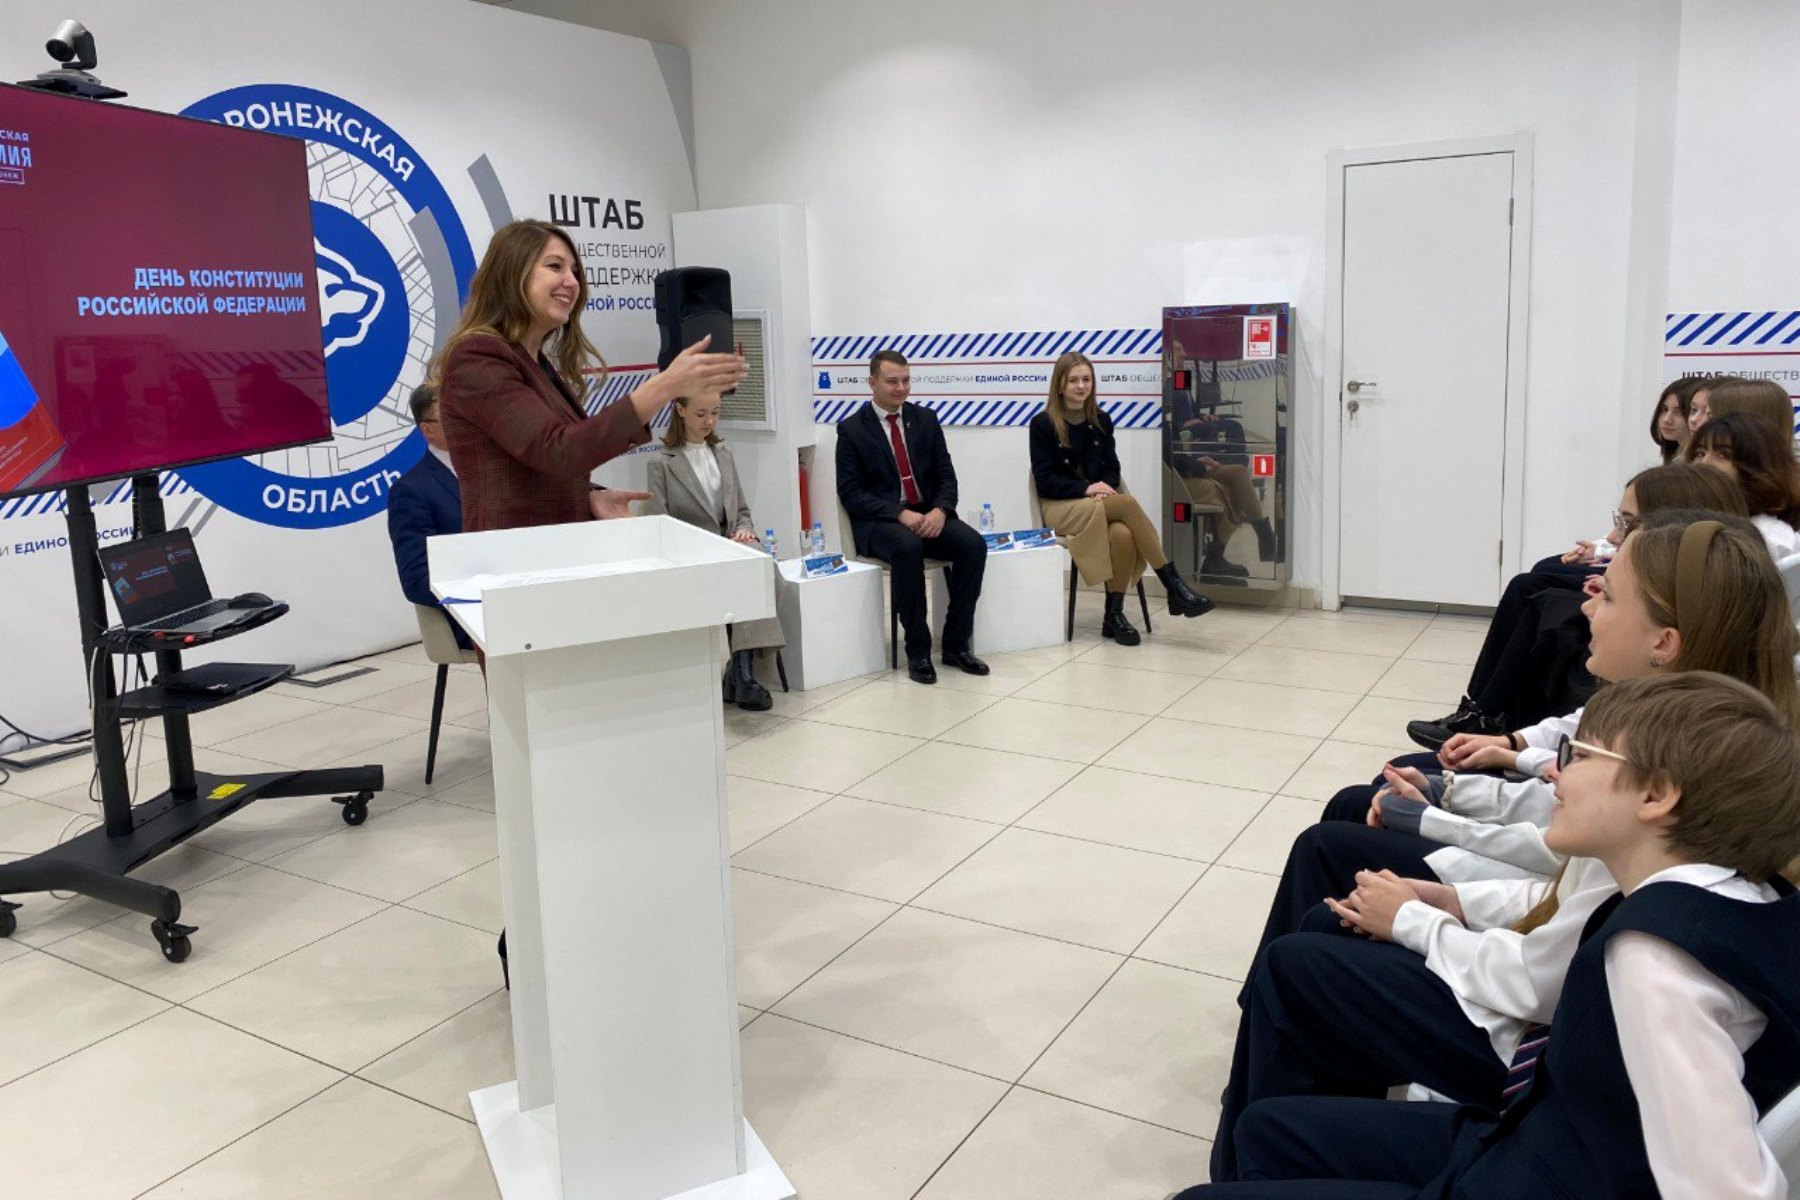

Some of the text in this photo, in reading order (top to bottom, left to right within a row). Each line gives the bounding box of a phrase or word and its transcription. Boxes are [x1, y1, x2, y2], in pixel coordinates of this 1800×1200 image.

[210, 101, 415, 182] РОНЕЖСКАЯ
[549, 193, 644, 230] ШТАБ
[578, 242, 666, 259] ЩЕСТВЕННОЙ
[134, 268, 304, 291] ДЕНЬ КОНСТИТУЦИИ
[585, 267, 667, 288] ДДЕРЖК
[77, 292, 306, 316] РОССИЙСКОЙ ФЕДЕРАЦИИ
[586, 294, 658, 311] НОЙ РОСС
[837, 376, 858, 384] ШТАБ
[975, 374, 1010, 383] ЕДИНОЙ
[1012, 374, 1047, 382] РОССИИ
[263, 469, 402, 513] ОБЛАСТЬ
[14, 537, 68, 555] ЕДИНО
[95, 526, 134, 540] ОССИ
